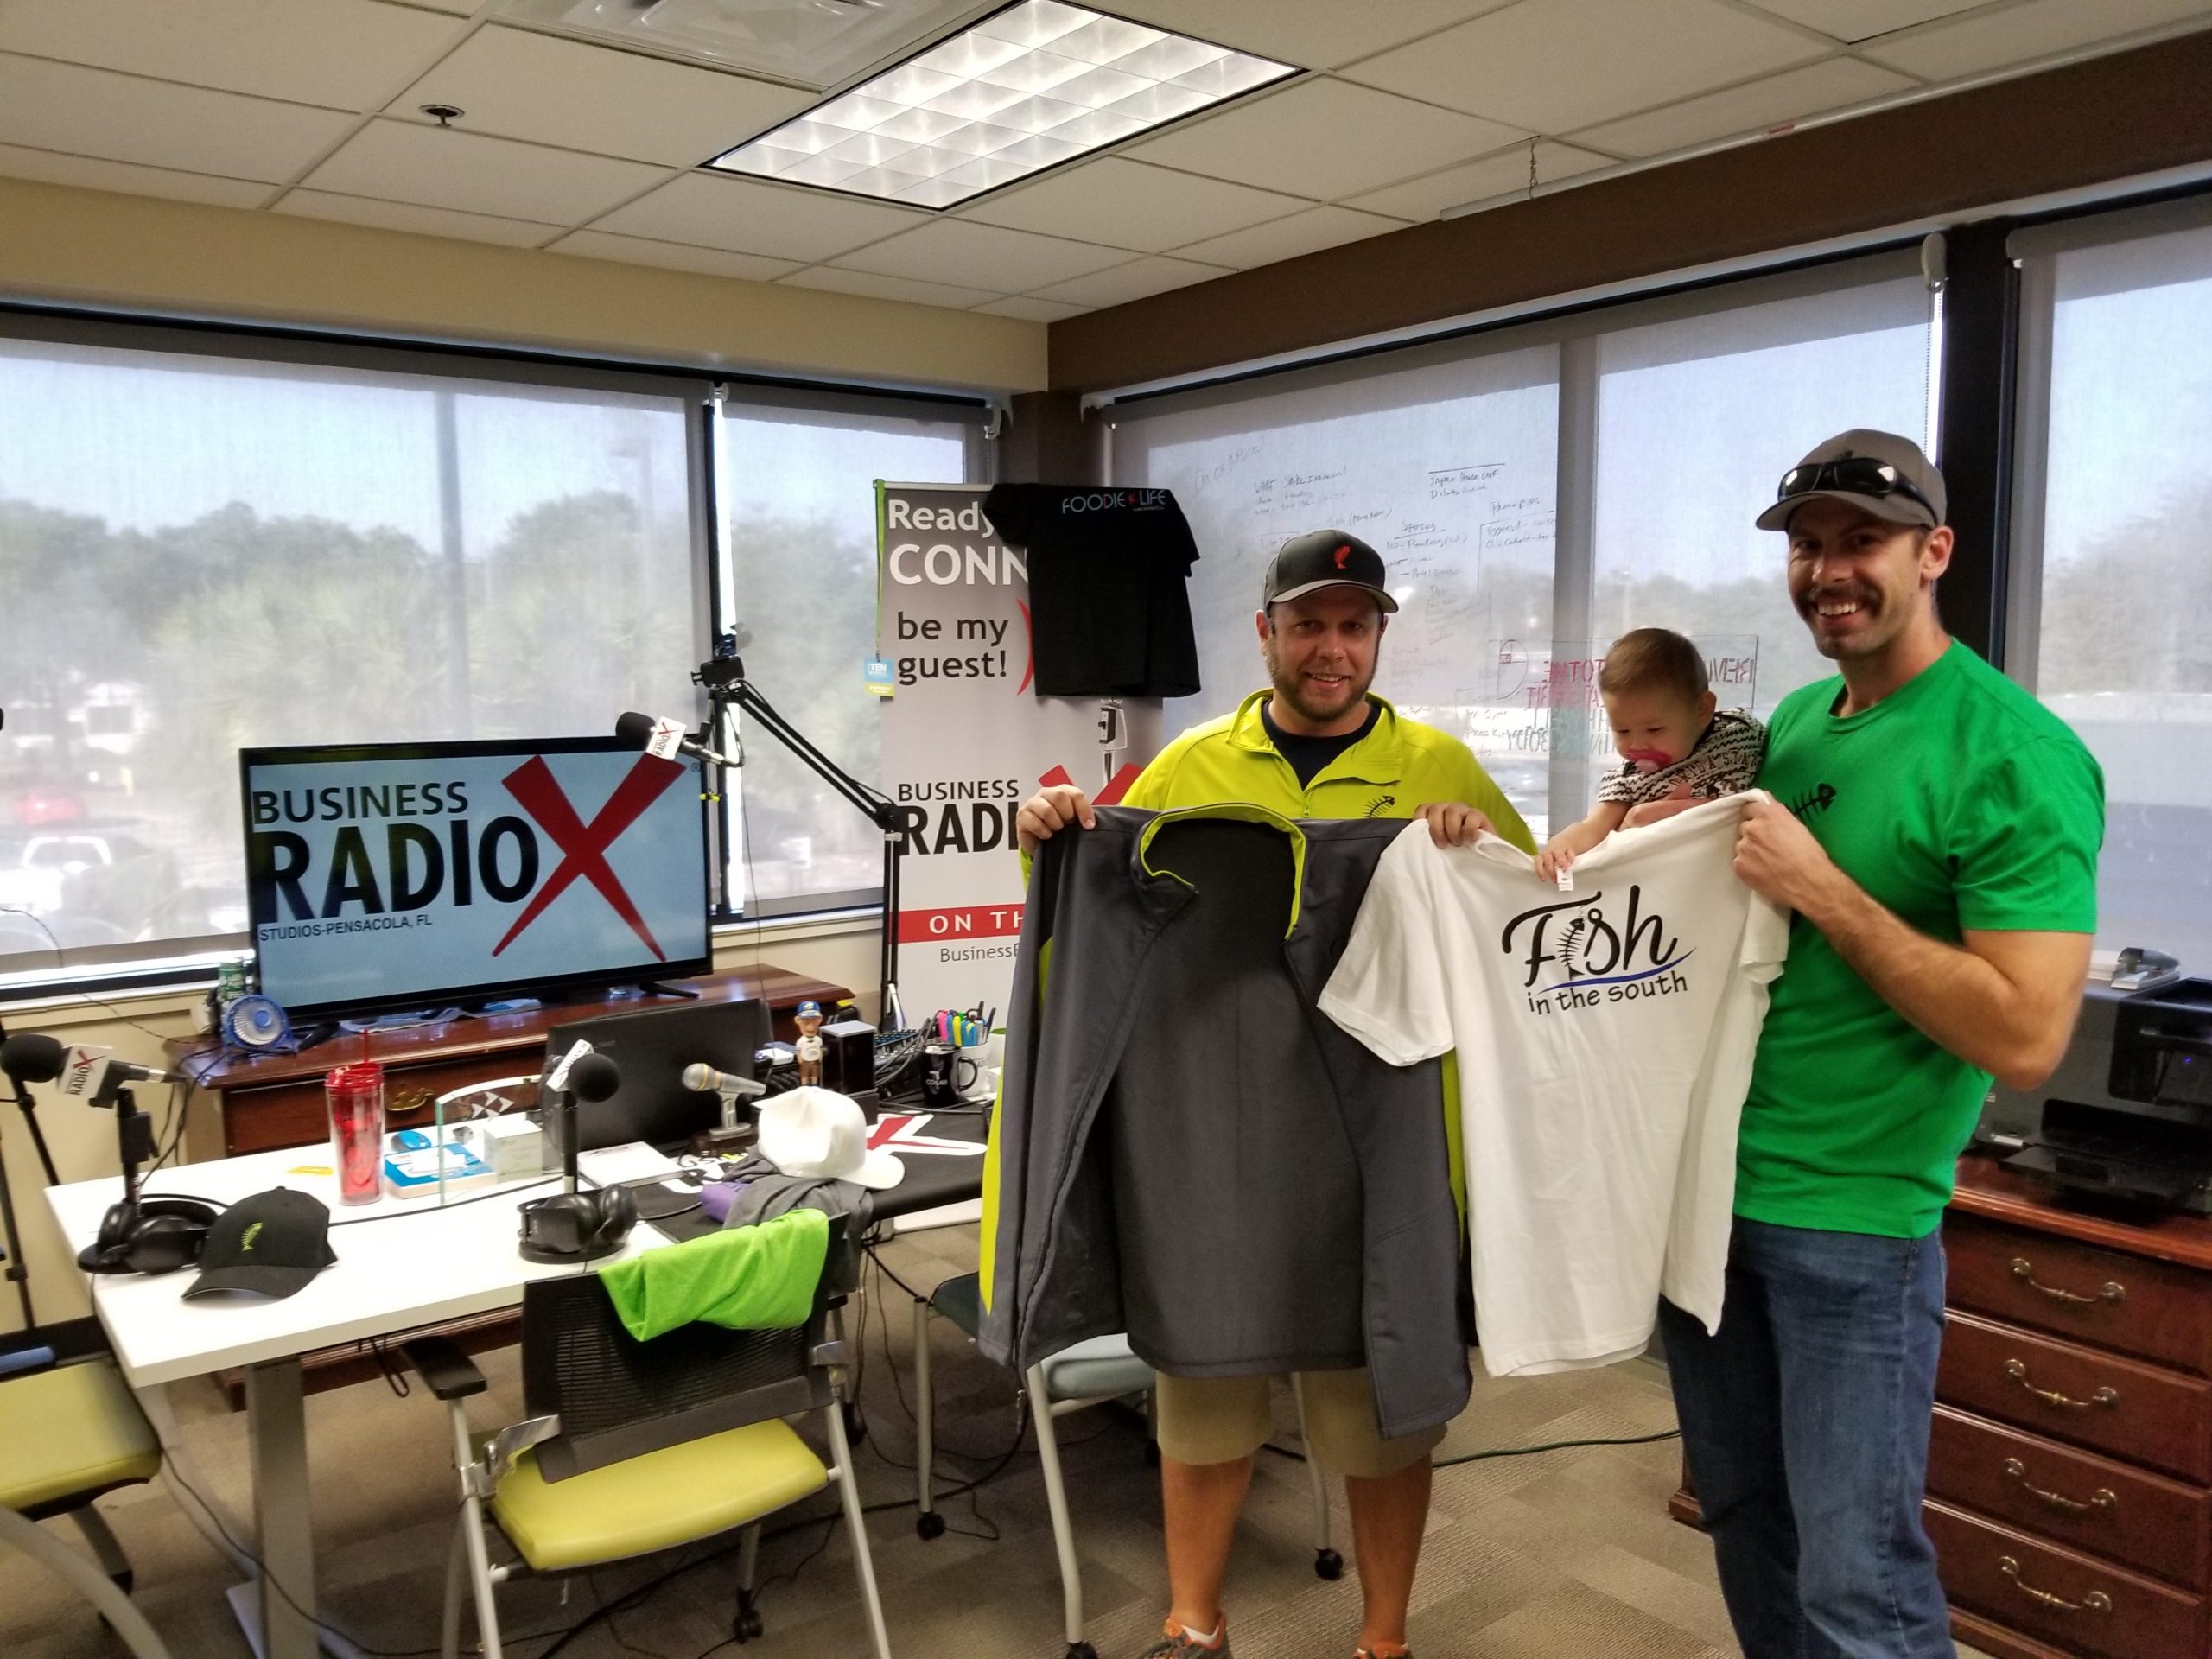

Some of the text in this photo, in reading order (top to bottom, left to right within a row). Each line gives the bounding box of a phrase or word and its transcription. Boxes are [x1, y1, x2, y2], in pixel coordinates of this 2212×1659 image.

[1062, 488, 1166, 514] FOODIE LIFE
[889, 543, 1028, 585] CONN
[898, 611, 1009, 647] be my
[898, 650, 1007, 686] guest!
[252, 781, 468, 825] BUSINESS
[898, 779, 1020, 802] BUSINESS
[253, 815, 539, 925] RADIO
[416, 913, 433, 927] FL
[928, 912, 972, 934] ON
[1527, 969, 1688, 1015] in the south
[68, 1065, 91, 1096] RADIO
